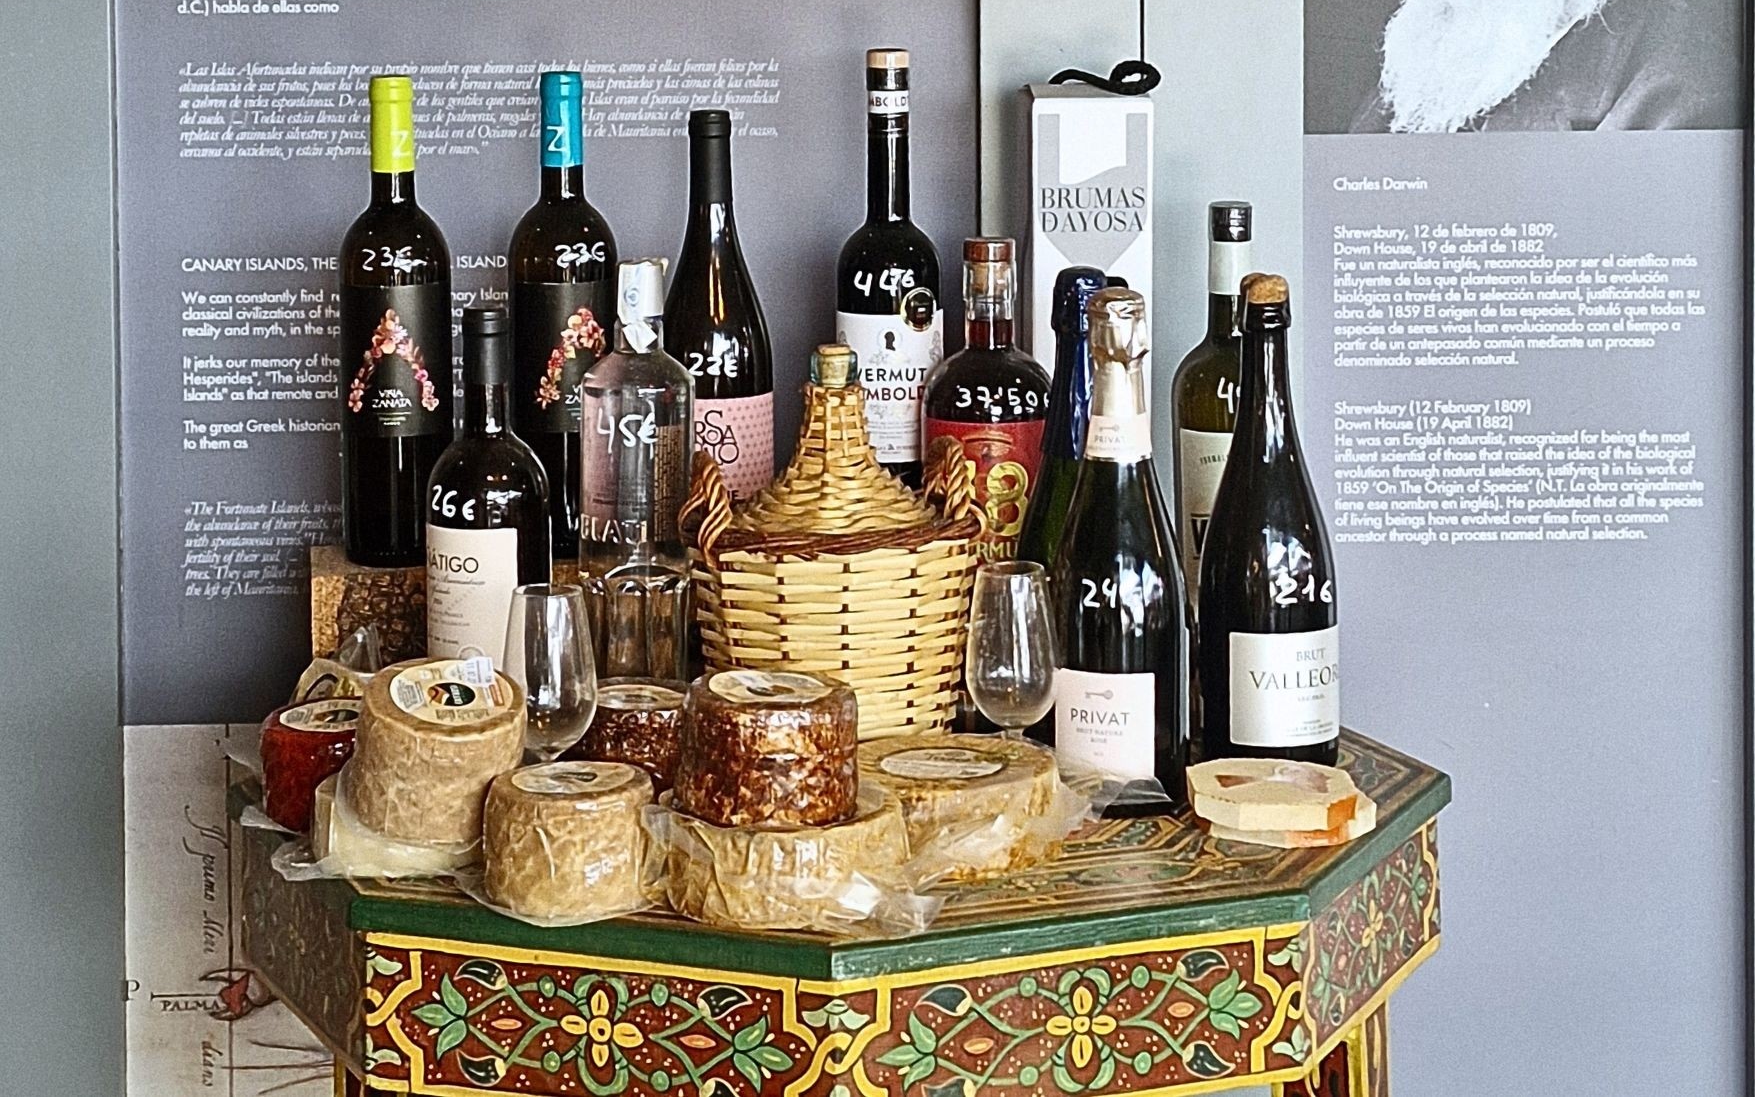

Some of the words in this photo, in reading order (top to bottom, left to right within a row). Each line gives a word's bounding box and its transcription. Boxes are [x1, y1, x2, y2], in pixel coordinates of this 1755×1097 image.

[1333, 177, 1380, 191] Charles
[1382, 177, 1427, 190] Darwin
[1040, 186, 1146, 209] BRUMAS
[1333, 225, 1408, 243] Shrewsbury,
[1414, 224, 1429, 238] 12
[1432, 224, 1449, 238] de
[1451, 224, 1497, 238] febrero
[1500, 224, 1517, 238] de
[1521, 224, 1557, 240] 1809,
[1333, 241, 1370, 254] Down
[1374, 240, 1416, 256] House,
[1421, 240, 1436, 254] 19
[1439, 240, 1456, 254] de
[1459, 240, 1487, 253] abril
[1490, 240, 1506, 253] de
[1511, 239, 1543, 253] 1882
[182, 258, 241, 272] CANARY
[246, 257, 307, 273] ISLANDS,
[312, 257, 336, 270] THE
[182, 323, 221, 341] reality
[224, 323, 249, 336] and
[252, 322, 286, 340] myth,
[290, 322, 301, 336] in
[304, 322, 323, 336] the
[183, 355, 191, 369] It
[194, 355, 222, 373] jerks
[226, 358, 247, 368] our
[250, 357, 301, 372] memory
[305, 353, 318, 367] of
[321, 353, 340, 366] the
[1334, 353, 1411, 367] denominado
[1414, 352, 1469, 366] selección
[1472, 352, 1518, 366] natural.
[230, 390, 244, 400] as
[246, 386, 268, 400] that
[271, 386, 312, 400] remote
[314, 386, 338, 399] and
[1334, 401, 1406, 419] Shrewsbury
[1409, 401, 1431, 419] (12
[1434, 400, 1490, 418] February
[1494, 400, 1531, 418] 1809)
[183, 419, 206, 433] The
[209, 419, 243, 437] great
[246, 419, 285, 432] Greek
[288, 418, 340, 432] historian
[1334, 417, 1371, 431] Down
[1374, 417, 1413, 430] House
[1416, 416, 1438, 434] (19
[1442, 416, 1471, 434] April
[1476, 415, 1512, 433] 1882)
[1334, 433, 1352, 447] He
[1356, 437, 1381, 447] was
[1383, 436, 1400, 447] an
[1403, 432, 1445, 450] English
[1448, 432, 1506, 448] naturalist,
[1508, 431, 1578, 449] recognized
[1580, 431, 1598, 444] for
[1600, 430, 1636, 448] being
[1638, 430, 1658, 444] the
[1660, 430, 1690, 443] most
[1295, 647, 1327, 661] BRUT
[1070, 707, 1131, 726] PRIVAT
[161, 999, 222, 1012] PALMA
